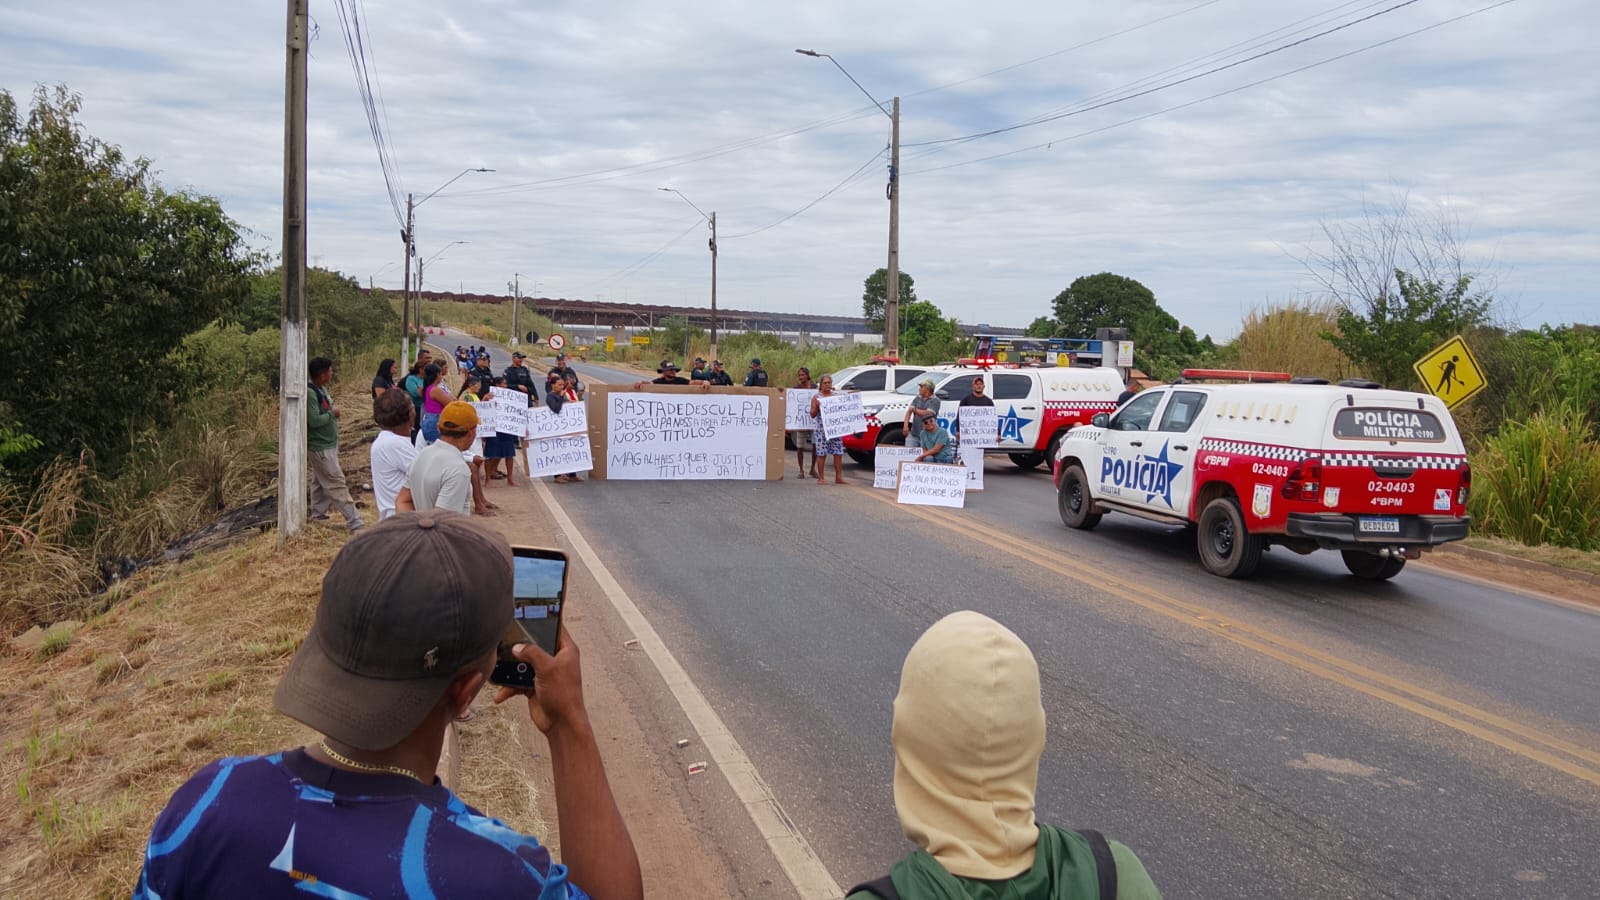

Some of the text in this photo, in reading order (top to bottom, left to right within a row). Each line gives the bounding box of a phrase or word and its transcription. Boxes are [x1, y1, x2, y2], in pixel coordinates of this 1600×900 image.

[538, 417, 583, 432] NOSSOS
[1353, 410, 1421, 427] POLÍCIA
[613, 427, 716, 444] NOSSO TITULOS
[1363, 426, 1414, 438] MILITAR
[540, 436, 585, 453] DIRETOS
[656, 465, 708, 477] TITULOS
[1101, 454, 1165, 495] POLÍCIA
[1252, 463, 1288, 477] 02-0403
[1100, 484, 1120, 496] MILITAR
[1367, 481, 1415, 493] 02-0403
